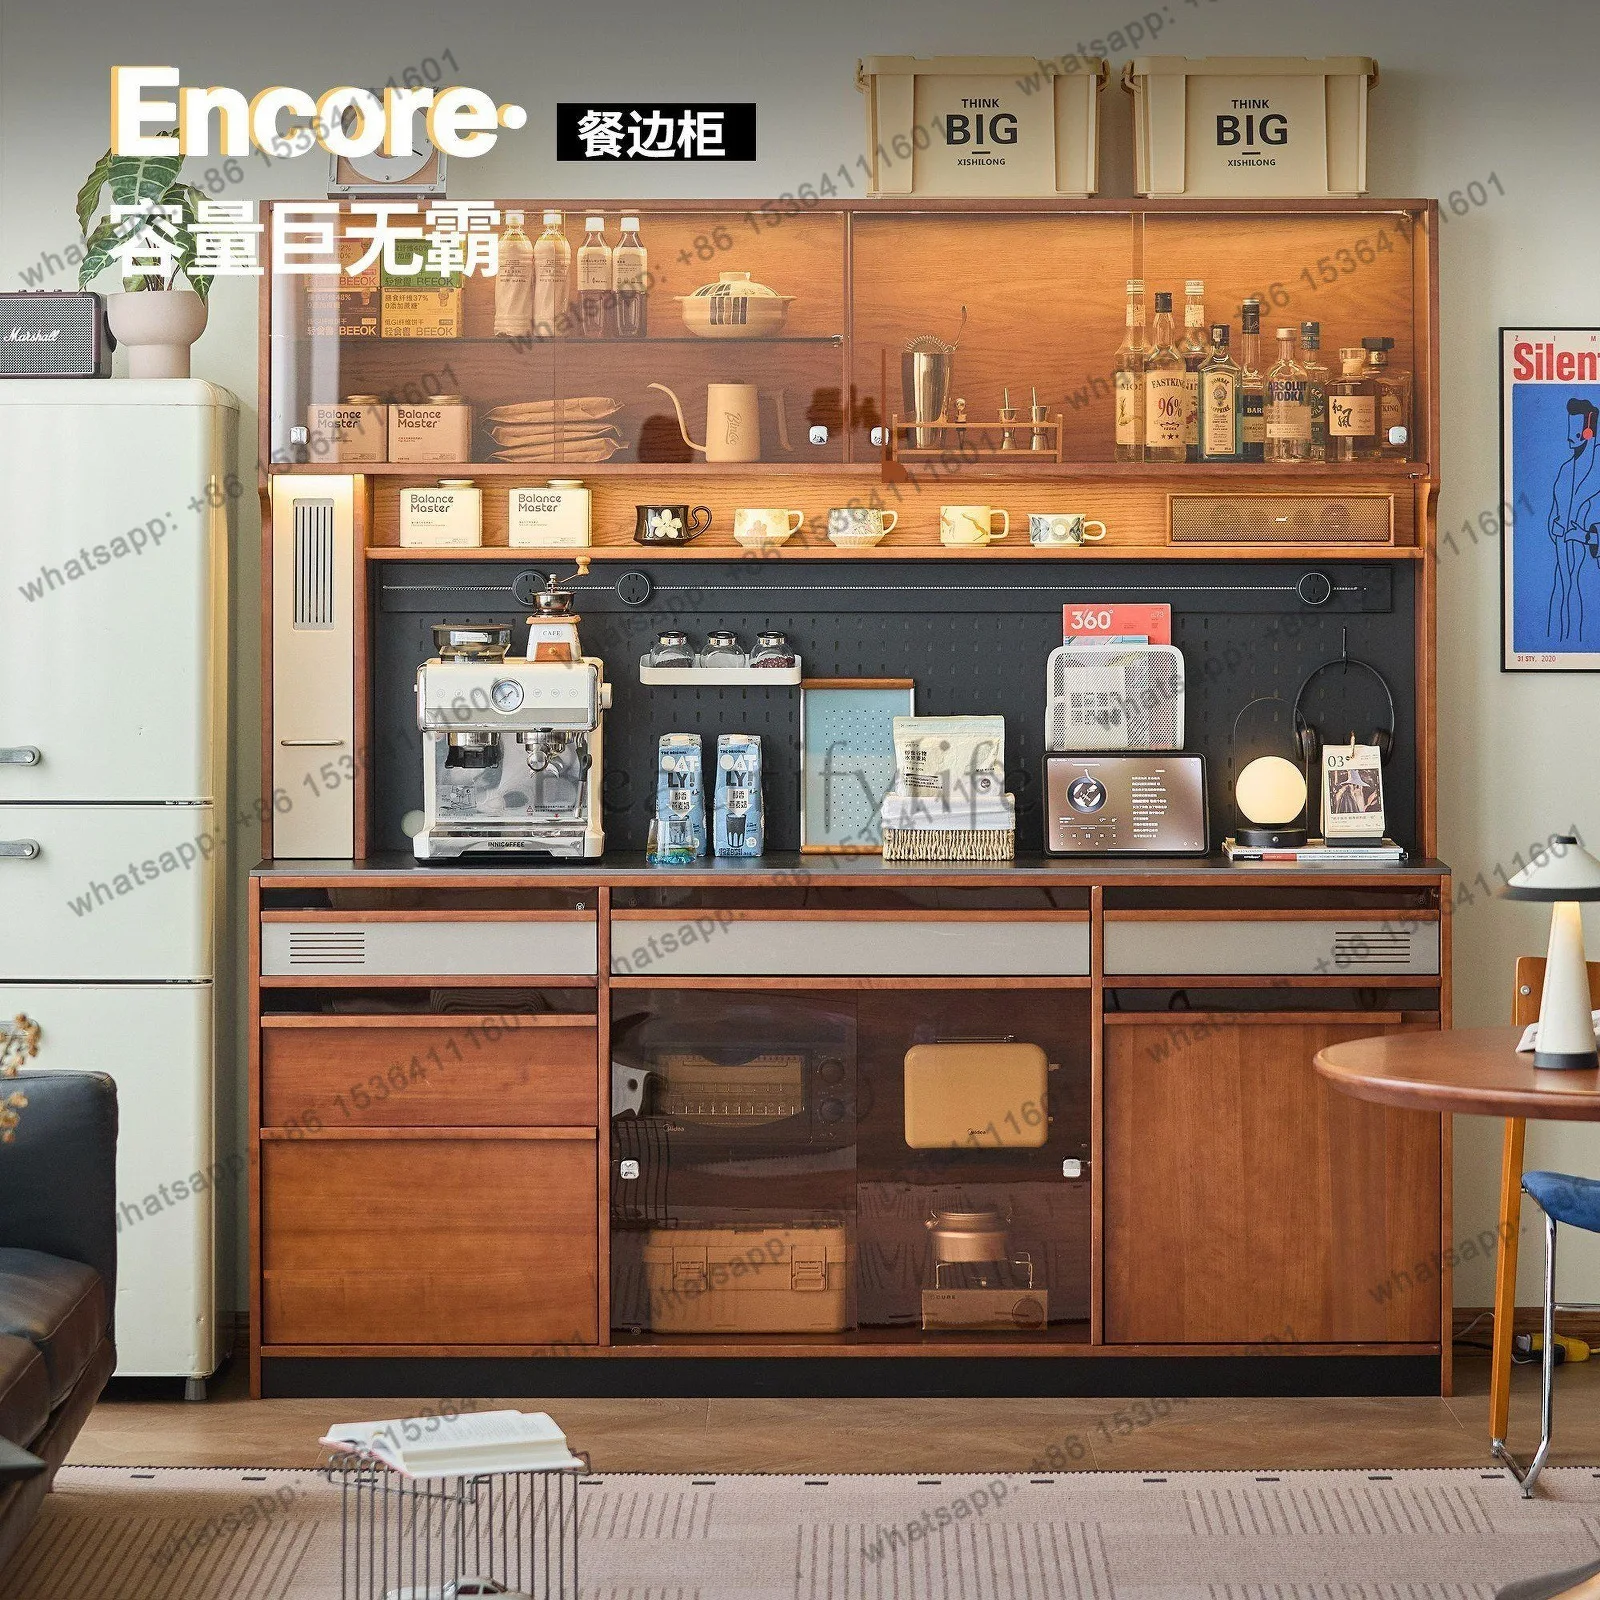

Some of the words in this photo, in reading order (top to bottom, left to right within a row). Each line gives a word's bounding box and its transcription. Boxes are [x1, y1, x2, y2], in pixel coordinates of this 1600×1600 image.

[962, 99, 1000, 109] THINK
[1232, 100, 1270, 110] THINK
[946, 113, 1018, 145] BIG
[1216, 114, 1288, 146] BIG
[957, 158, 1006, 167] XISHILONG
[1227, 159, 1276, 168] XISHILONG
[339, 277, 376, 286] BEEOK
[417, 277, 454, 286] BEEOK
[3, 326, 61, 341] Marshall
[339, 326, 377, 336] BEEOK
[416, 327, 453, 336] BEEOK
[1268, 381, 1307, 391] ABSOLUT
[1272, 391, 1304, 402] VODKA
[1158, 395, 1182, 418] 96%
[318, 409, 361, 419] Balance
[398, 409, 441, 419] Balance
[410, 494, 454, 503] Balance
[518, 494, 562, 503] Balance
[667, 772, 695, 788] LY!
[726, 771, 754, 787] LY!
